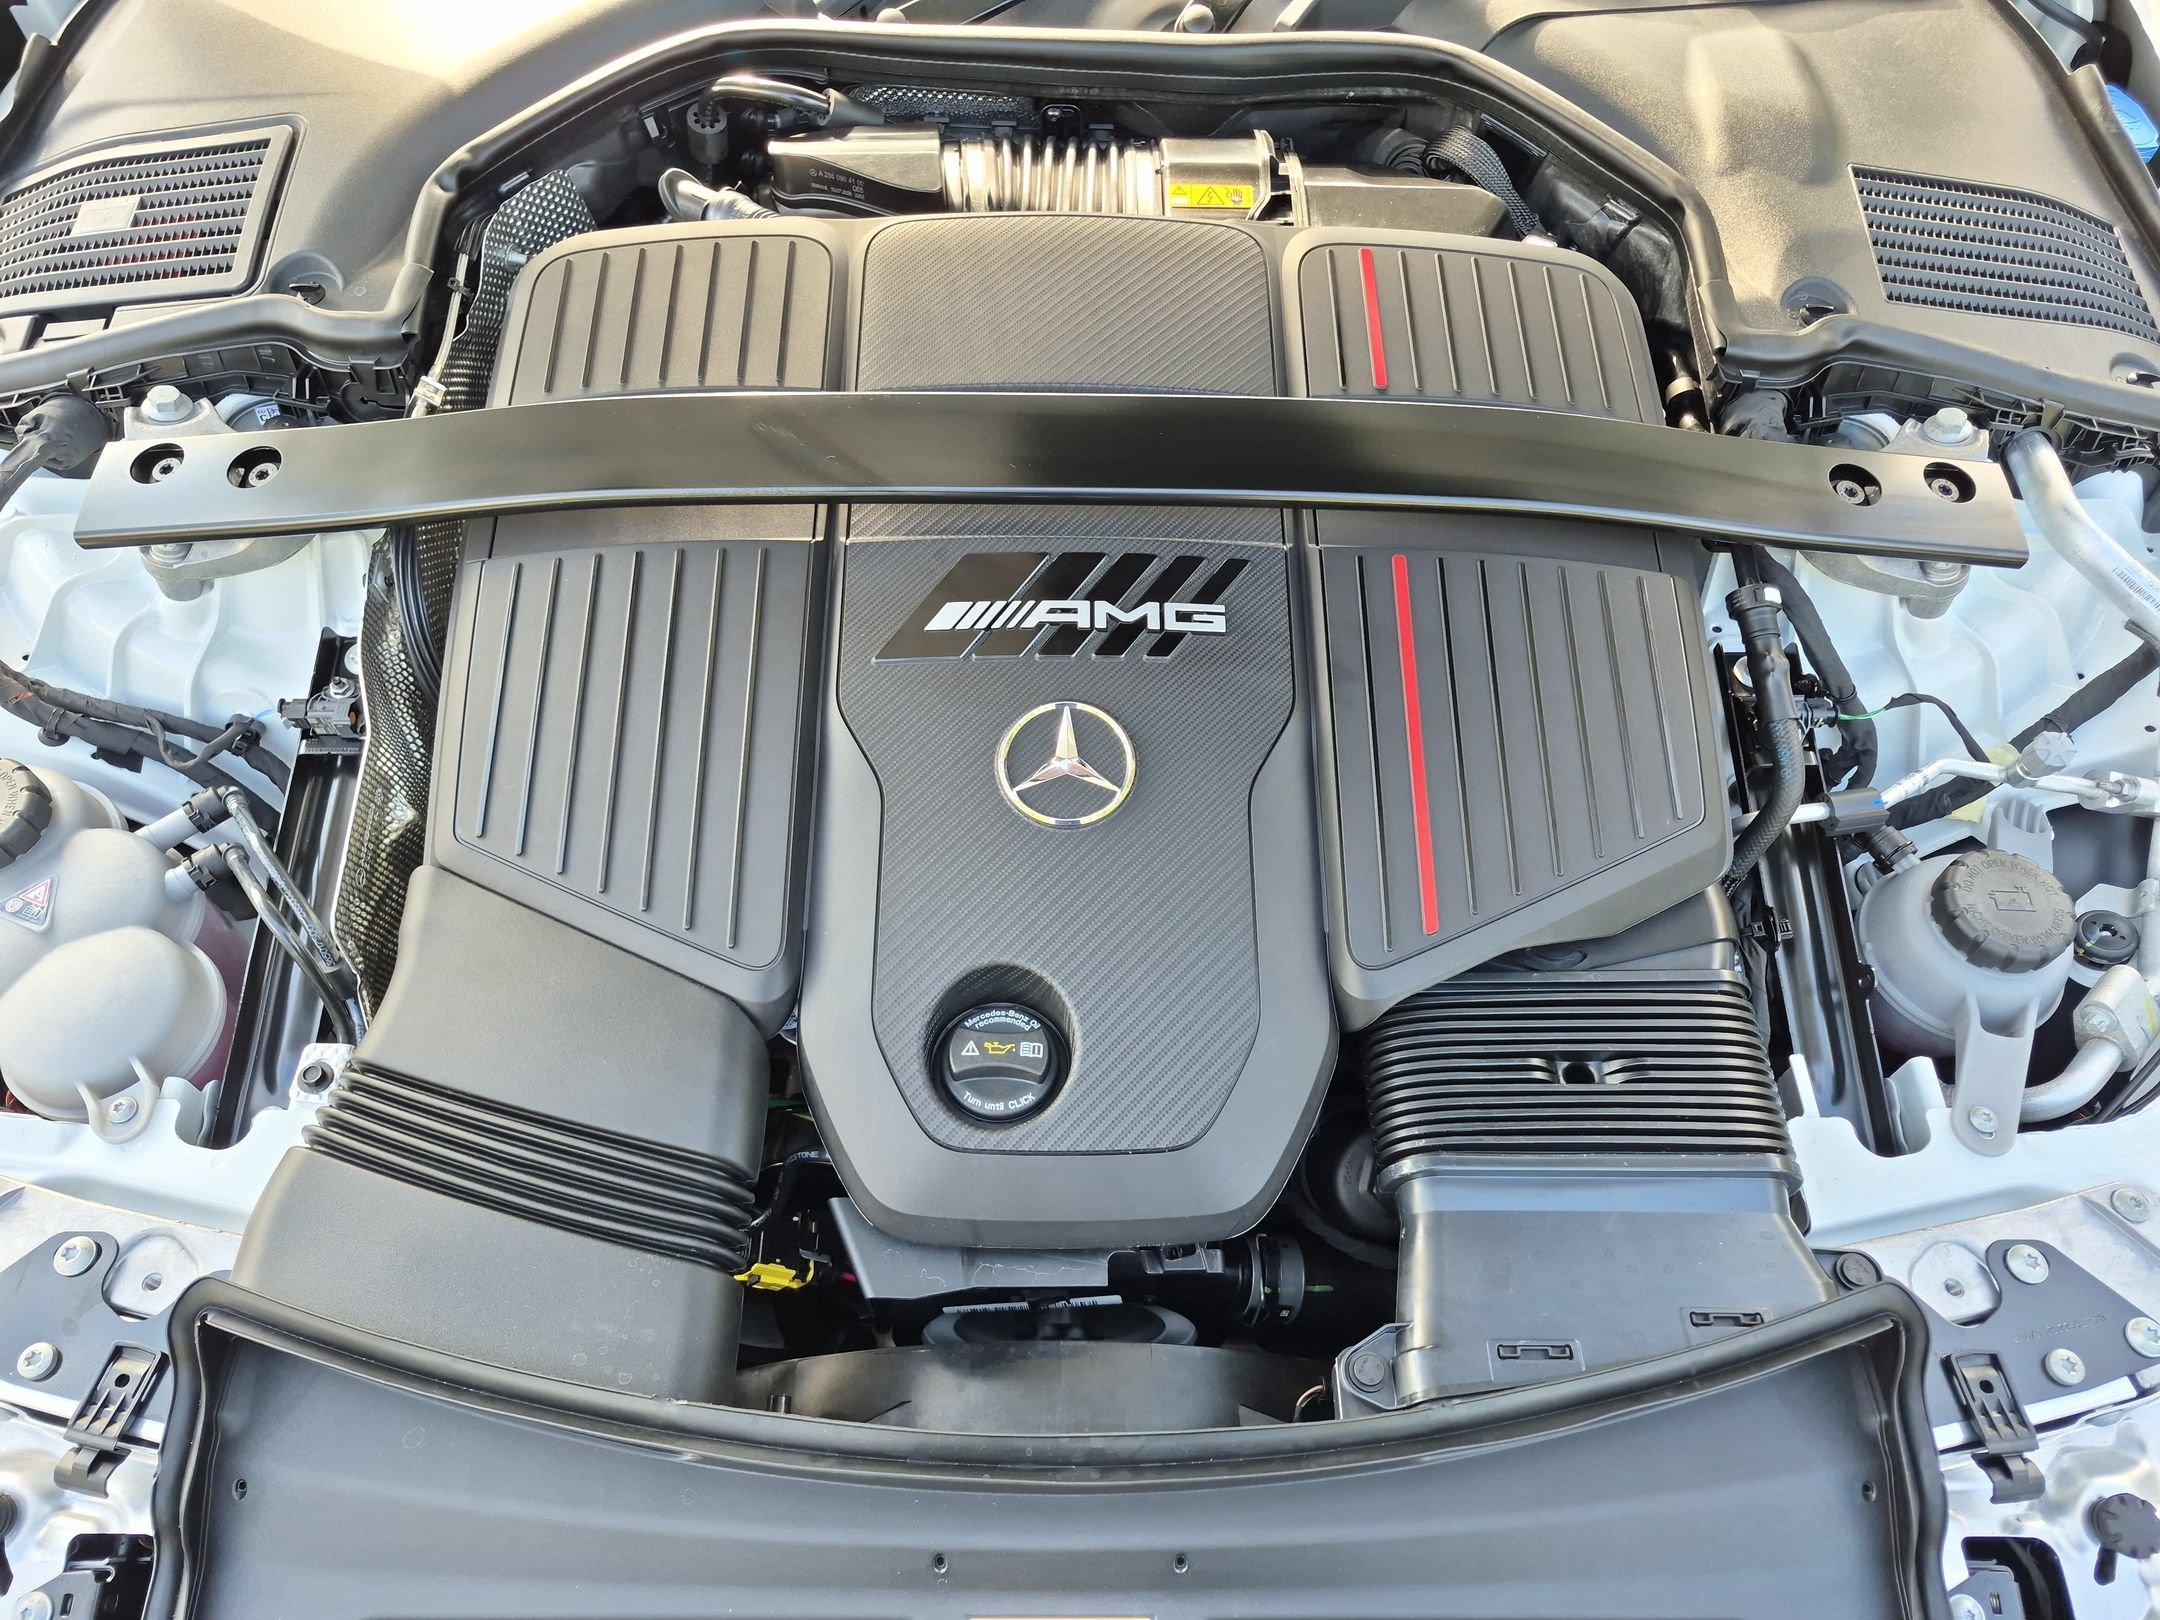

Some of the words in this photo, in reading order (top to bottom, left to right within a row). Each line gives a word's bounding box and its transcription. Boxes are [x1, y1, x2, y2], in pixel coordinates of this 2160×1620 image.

[1020, 599, 1227, 634] AMG
[1981, 858, 2007, 870] OPEN
[964, 1010, 1029, 1028] Mercedes-Benz
[1029, 1018, 1042, 1030] Oil
[974, 1015, 1032, 1031] recommended
[962, 1091, 982, 1107] Turn
[984, 1100, 1005, 1111] until
[1008, 1092, 1037, 1110] CLICK
